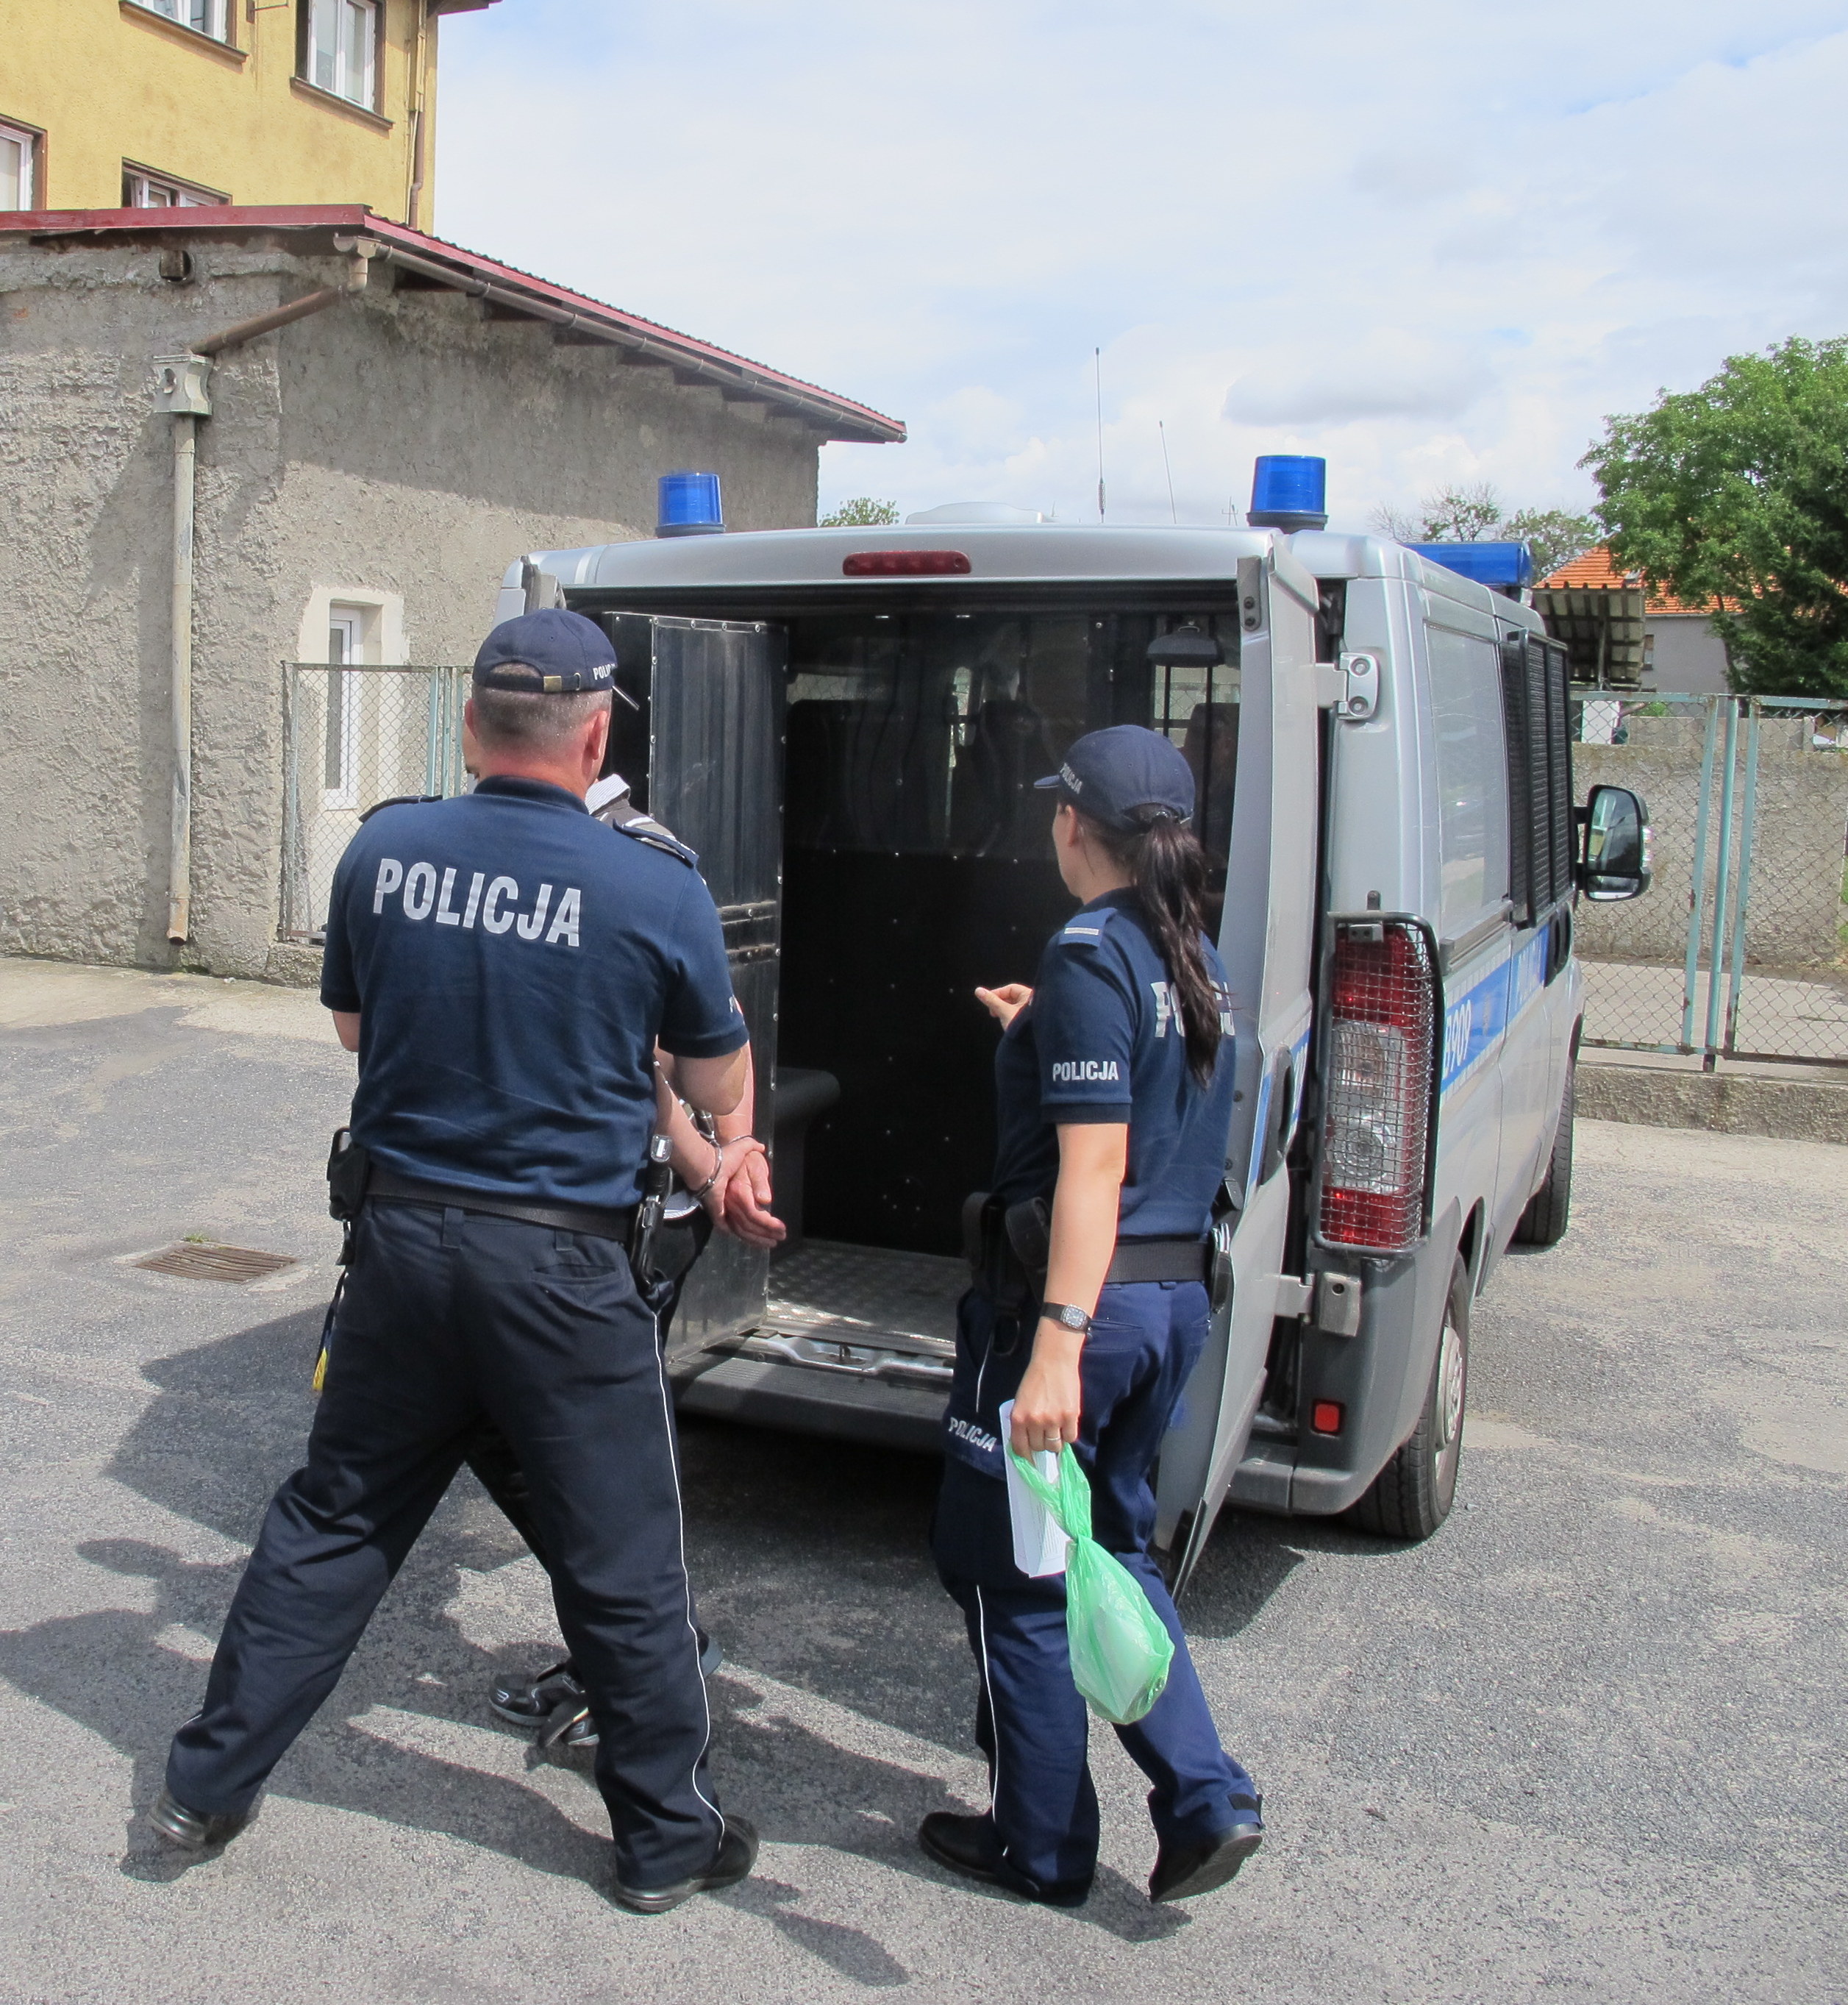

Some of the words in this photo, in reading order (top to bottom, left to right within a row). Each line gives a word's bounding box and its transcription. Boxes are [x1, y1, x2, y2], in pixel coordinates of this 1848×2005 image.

[1060, 762, 1082, 794] POLICJA
[373, 858, 582, 947] POLICJA
[1052, 1061, 1119, 1081] POLICJA
[948, 1417, 997, 1452] POLICJA
